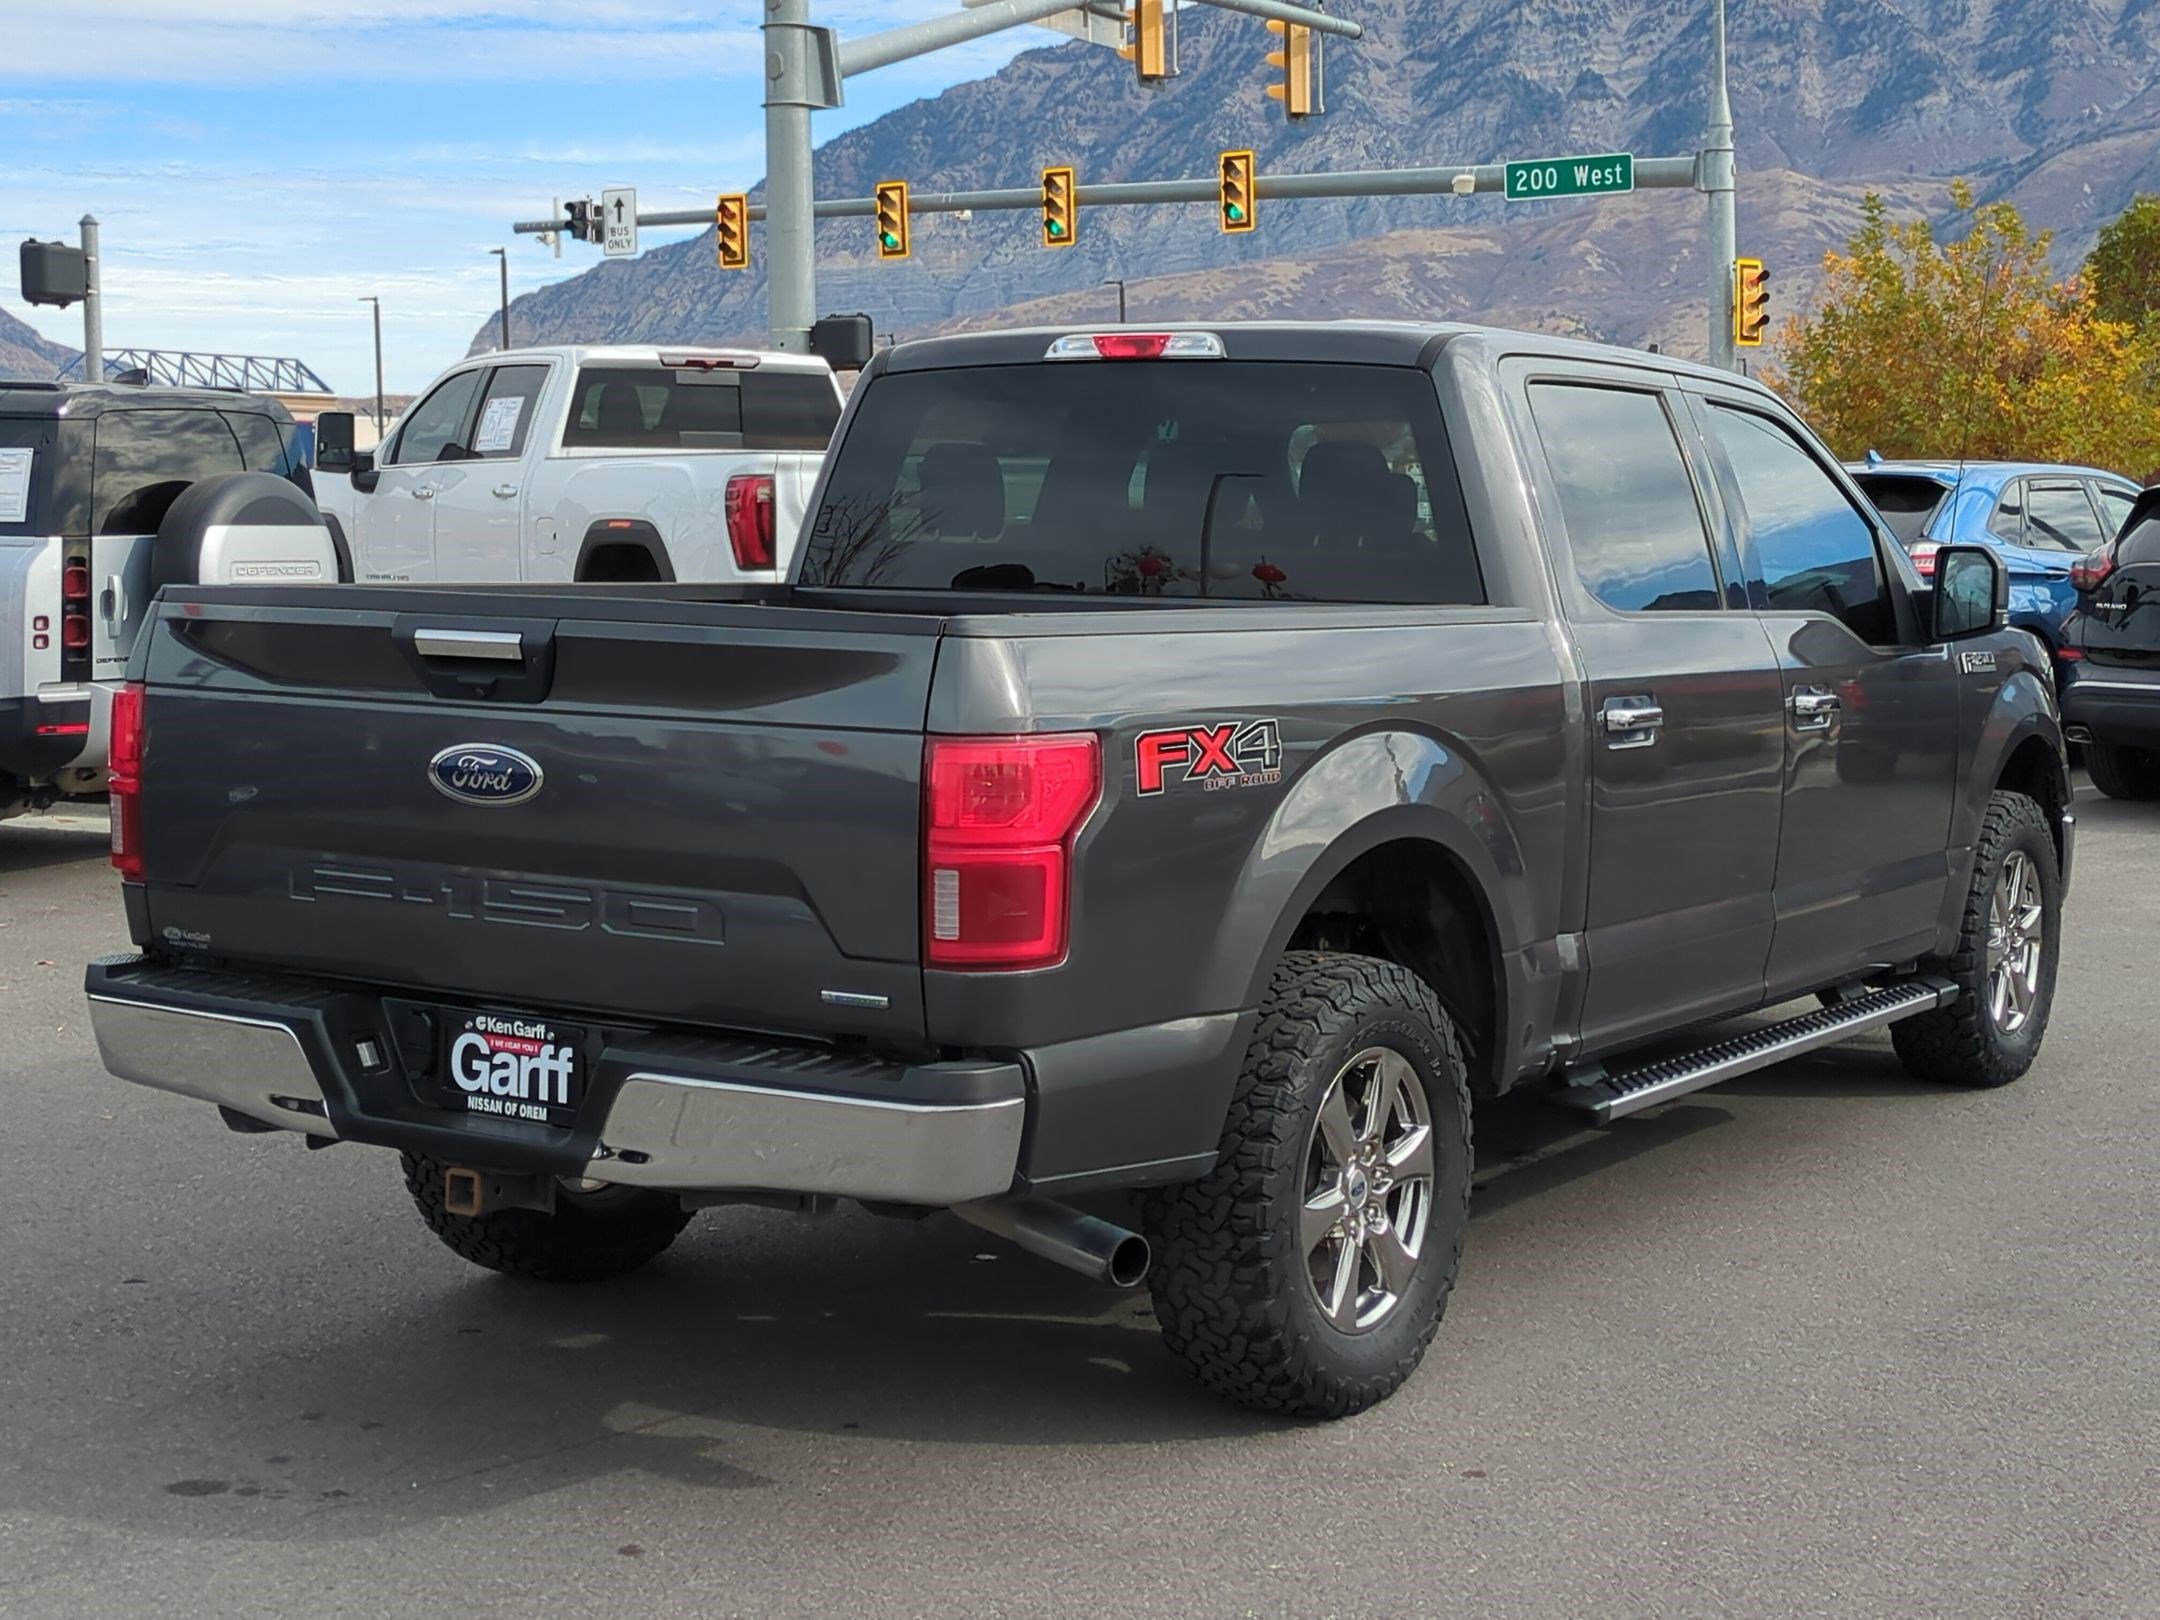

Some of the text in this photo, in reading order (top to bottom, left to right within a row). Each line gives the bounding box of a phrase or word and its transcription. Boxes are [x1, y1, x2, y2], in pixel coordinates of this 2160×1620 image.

[1515, 163, 1623, 191] 200 West
[610, 226, 629, 237] BUS
[608, 239, 632, 249] ONLY
[236, 566, 314, 576] DEFENDER
[1134, 718, 1283, 797] FX4
[452, 755, 512, 791] Ford
[1203, 771, 1281, 791] OFF ROAD
[289, 860, 726, 946] F-150
[487, 1017, 546, 1040] Ken Garff
[494, 1039, 504, 1048] WE
[521, 1043, 534, 1053] YOU
[451, 1032, 574, 1104] Garff
[467, 1095, 548, 1121] NISSAN OF OREM
